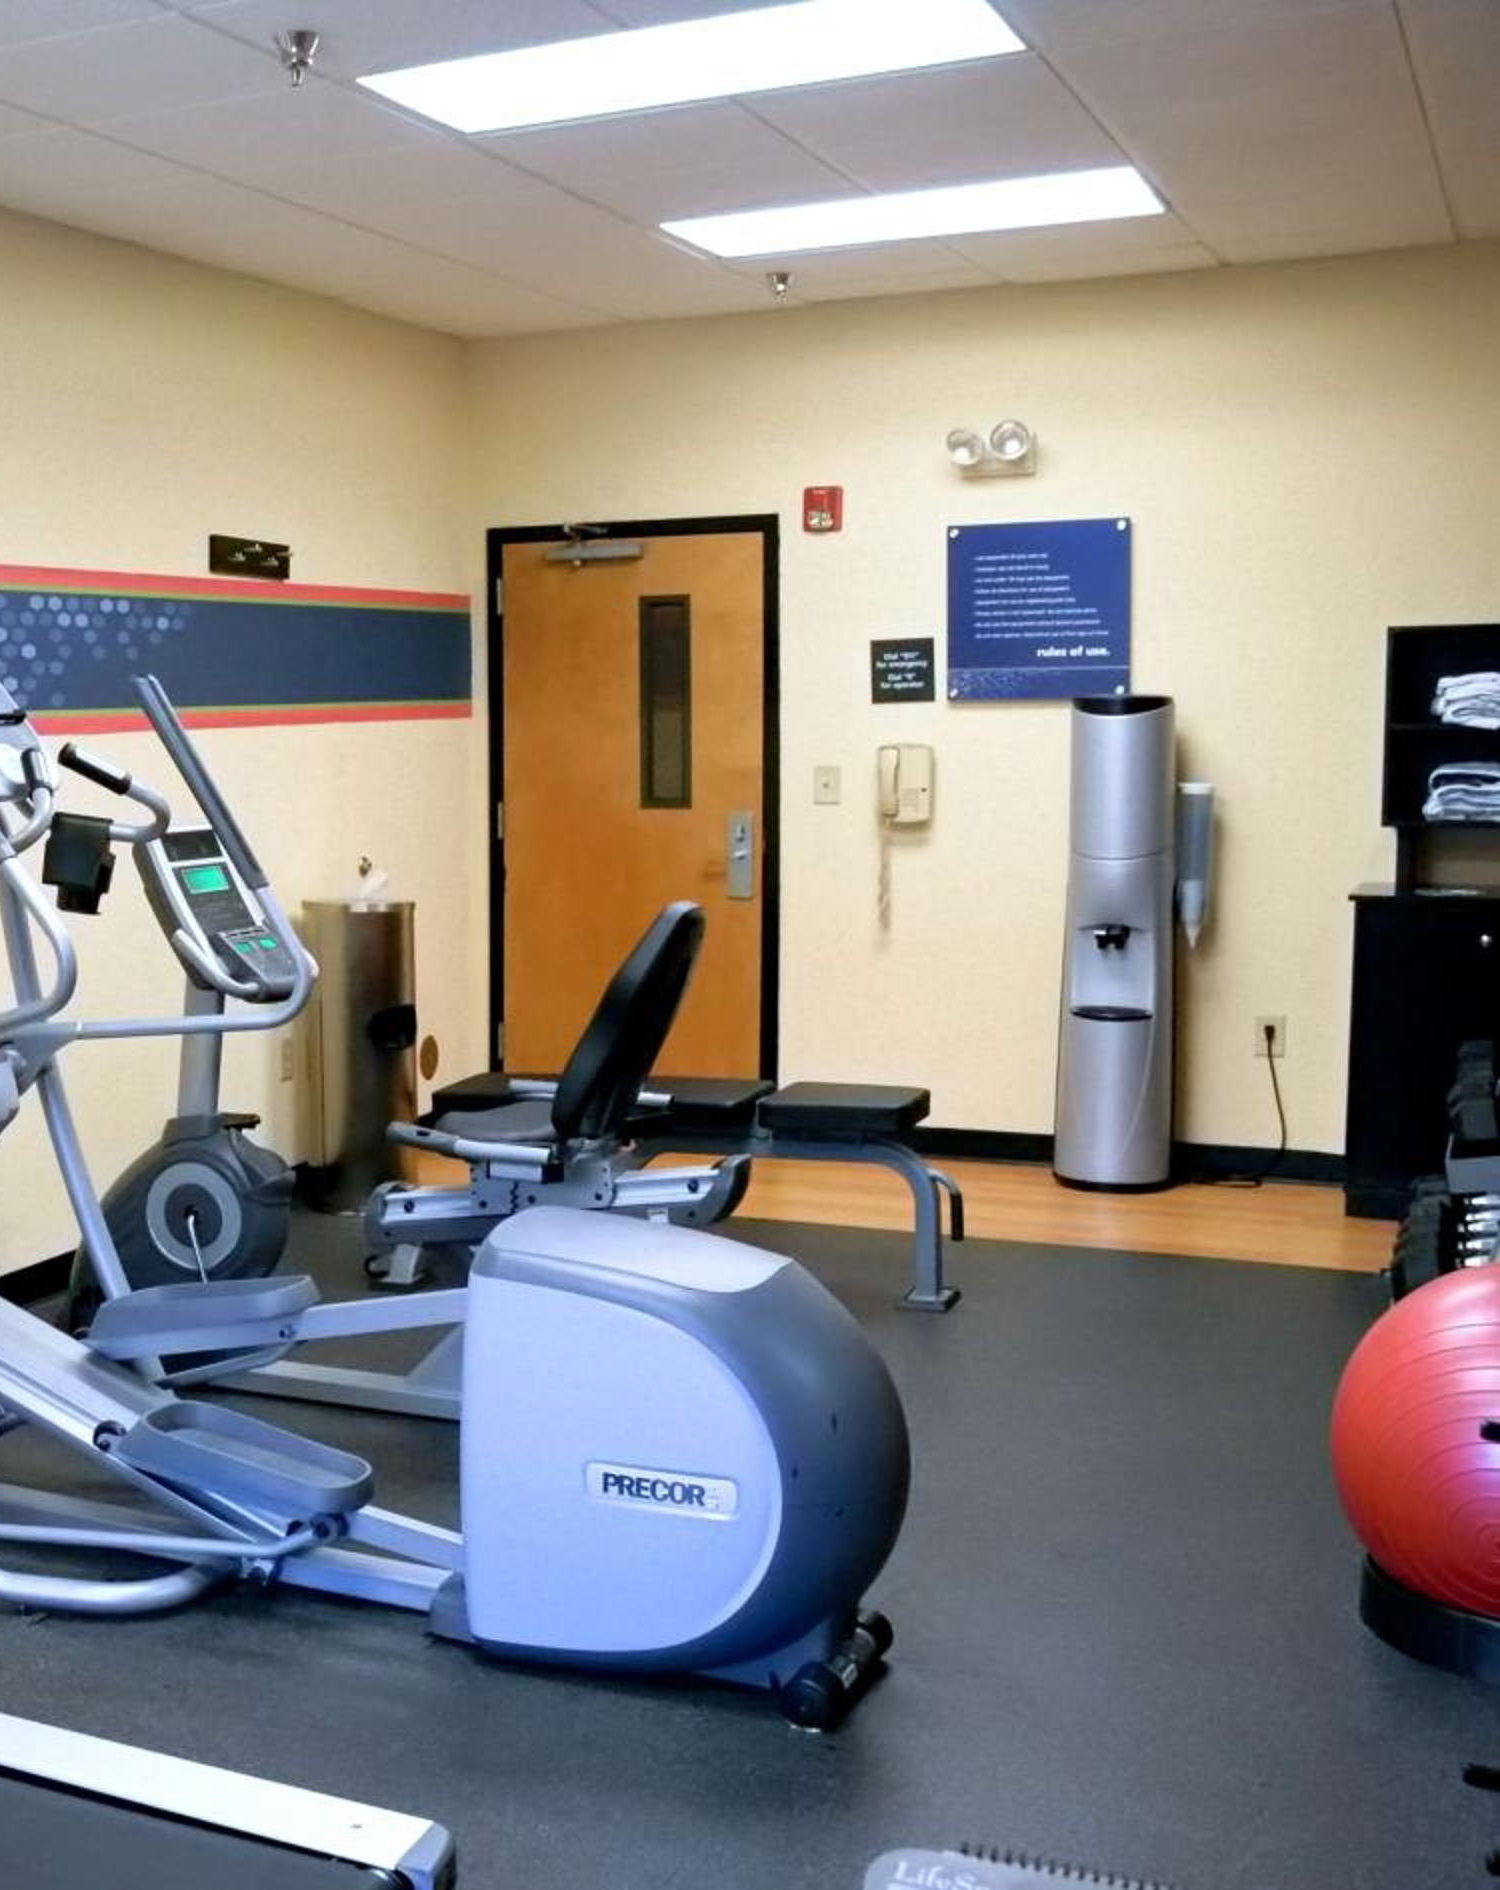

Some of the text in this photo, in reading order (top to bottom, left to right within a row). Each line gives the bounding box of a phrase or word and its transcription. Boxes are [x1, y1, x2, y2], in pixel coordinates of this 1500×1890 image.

[1036, 645, 1111, 657] rules of use.
[602, 1472, 706, 1507] PRECOR
